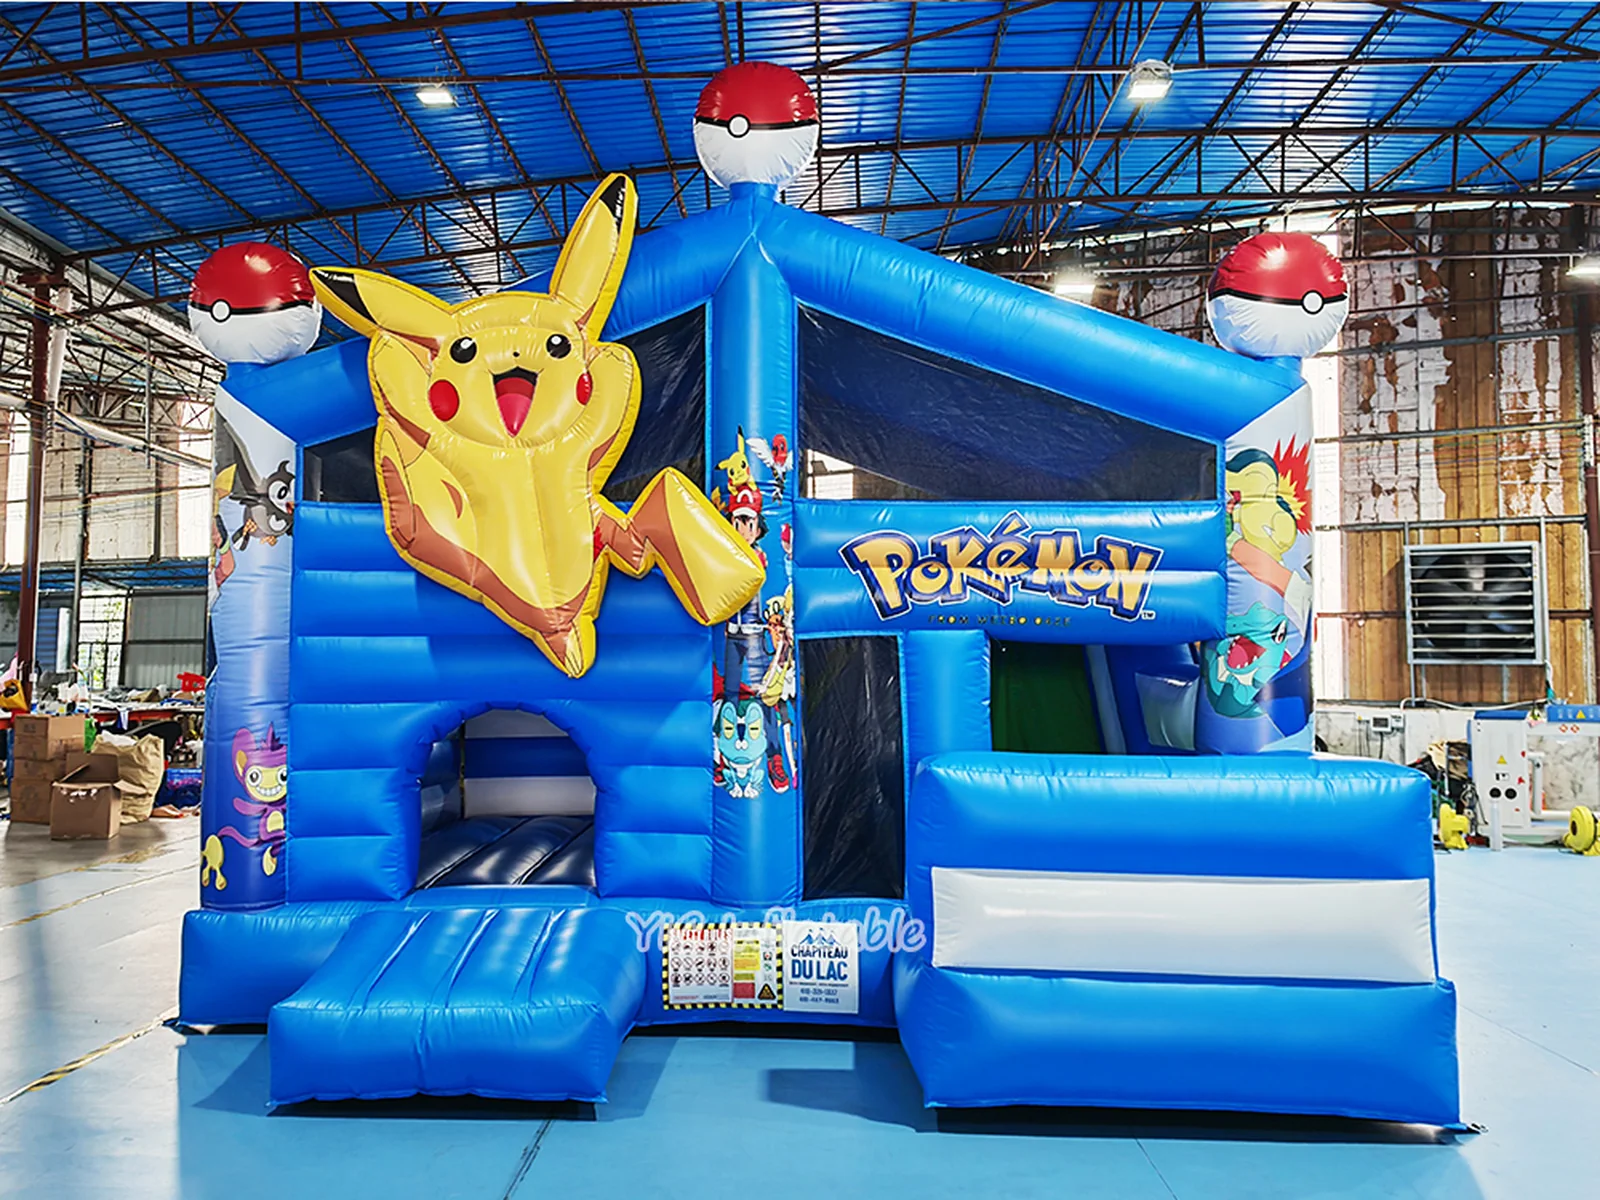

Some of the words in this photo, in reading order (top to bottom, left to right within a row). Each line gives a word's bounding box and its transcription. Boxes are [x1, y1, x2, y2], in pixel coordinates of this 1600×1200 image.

[927, 614, 969, 625] FROM
[791, 944, 849, 959] CHAPITEAU
[791, 959, 814, 980] DU
[816, 960, 848, 981] LAC
